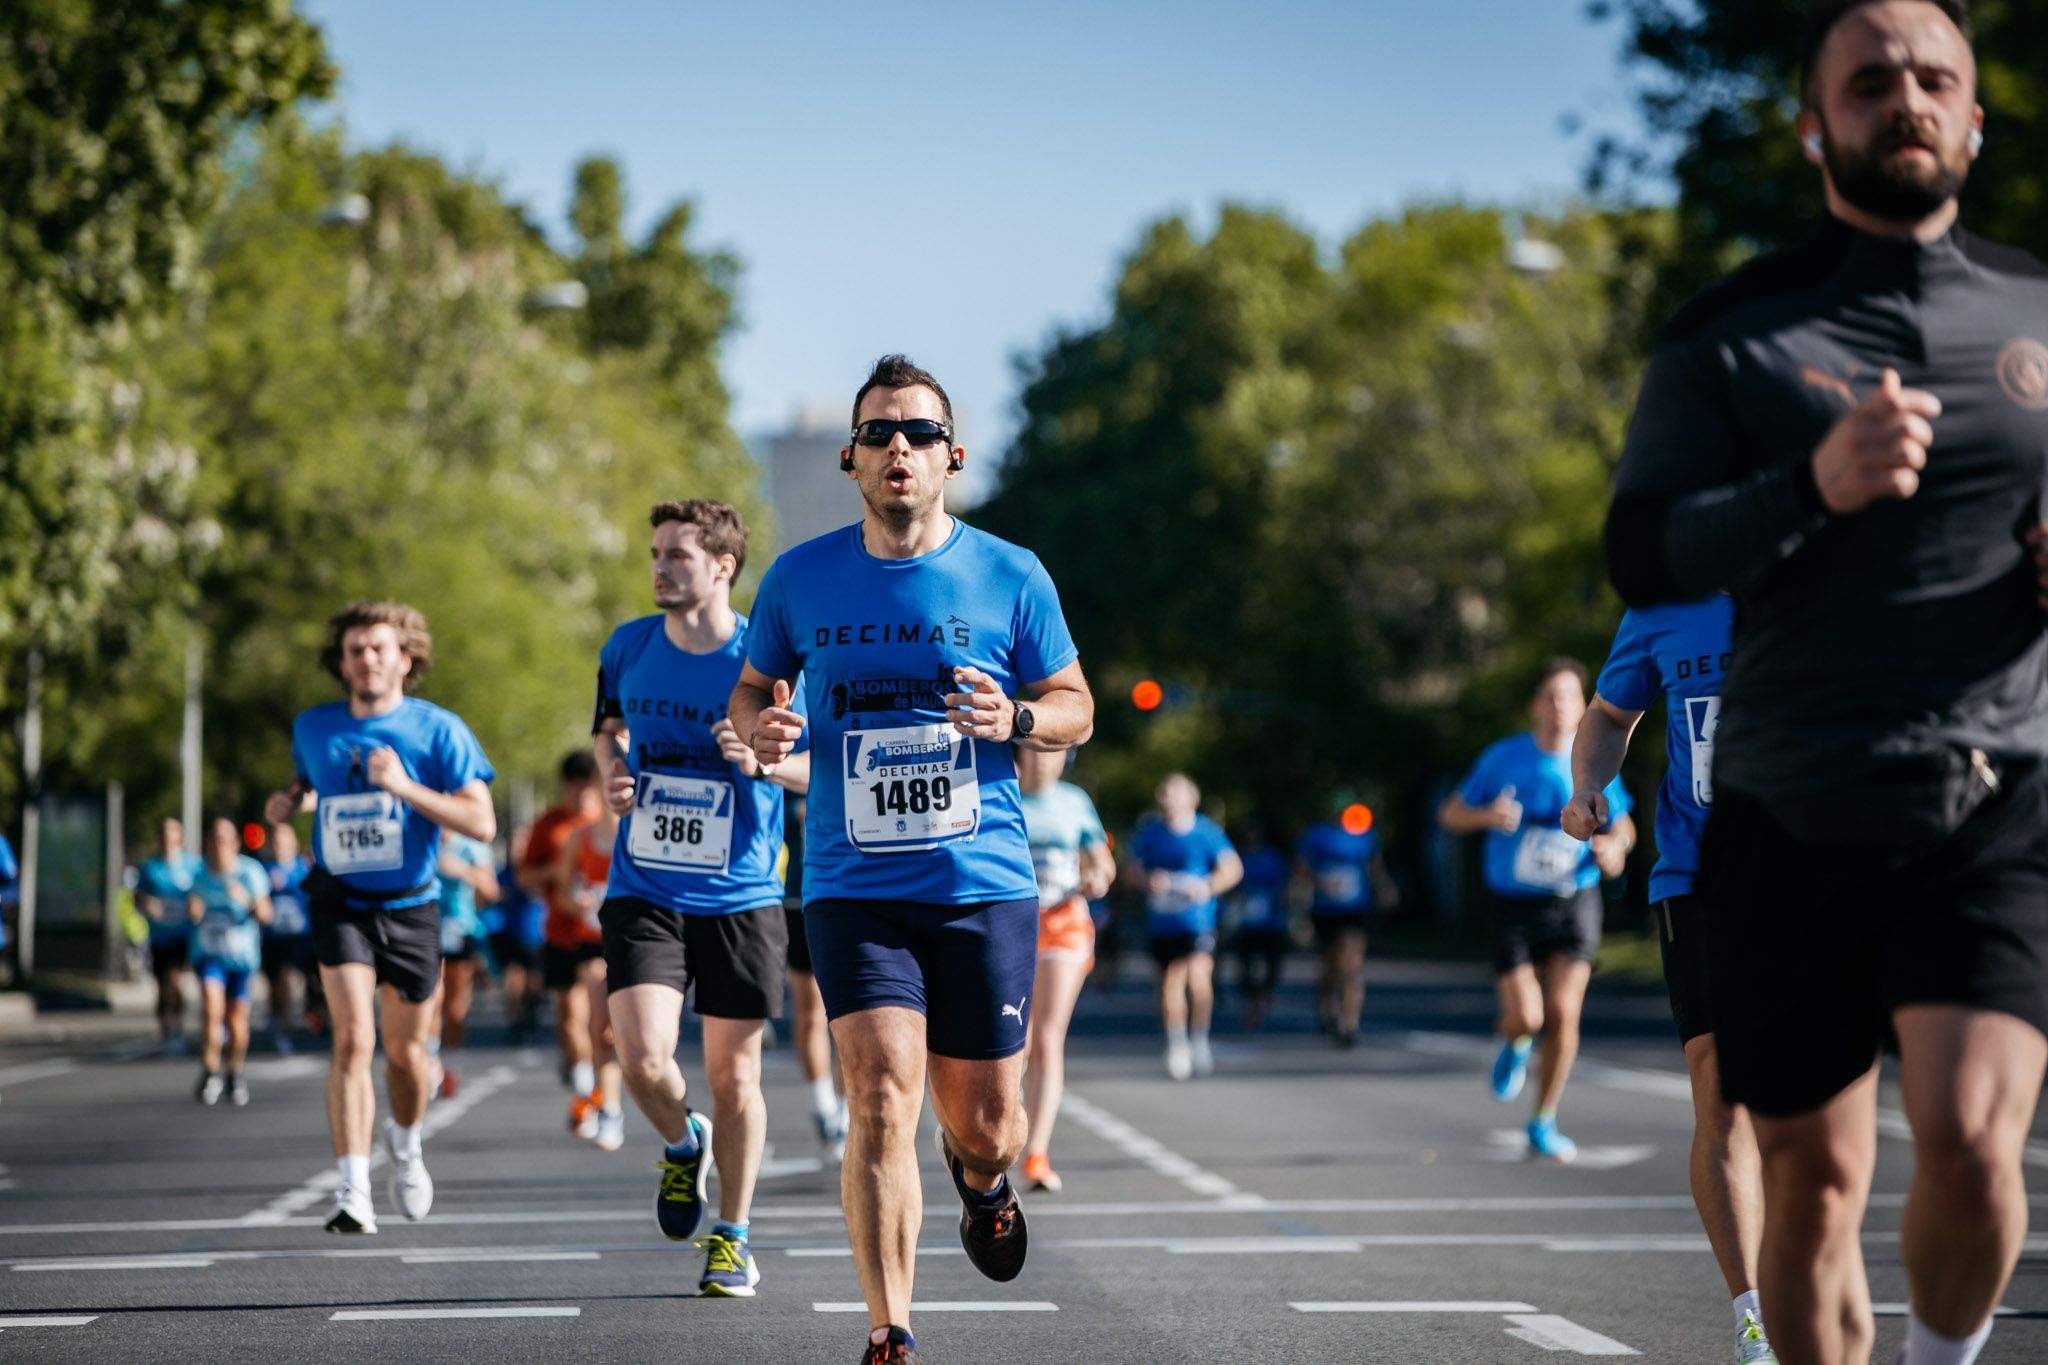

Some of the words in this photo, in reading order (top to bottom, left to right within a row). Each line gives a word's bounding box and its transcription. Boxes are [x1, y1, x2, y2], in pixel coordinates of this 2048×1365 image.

[815, 624, 971, 648] DECIMAS
[885, 742, 949, 757] BOMBEROS
[880, 762, 949, 778] DECIMAS
[869, 776, 953, 817] 1489
[653, 814, 704, 845] 386
